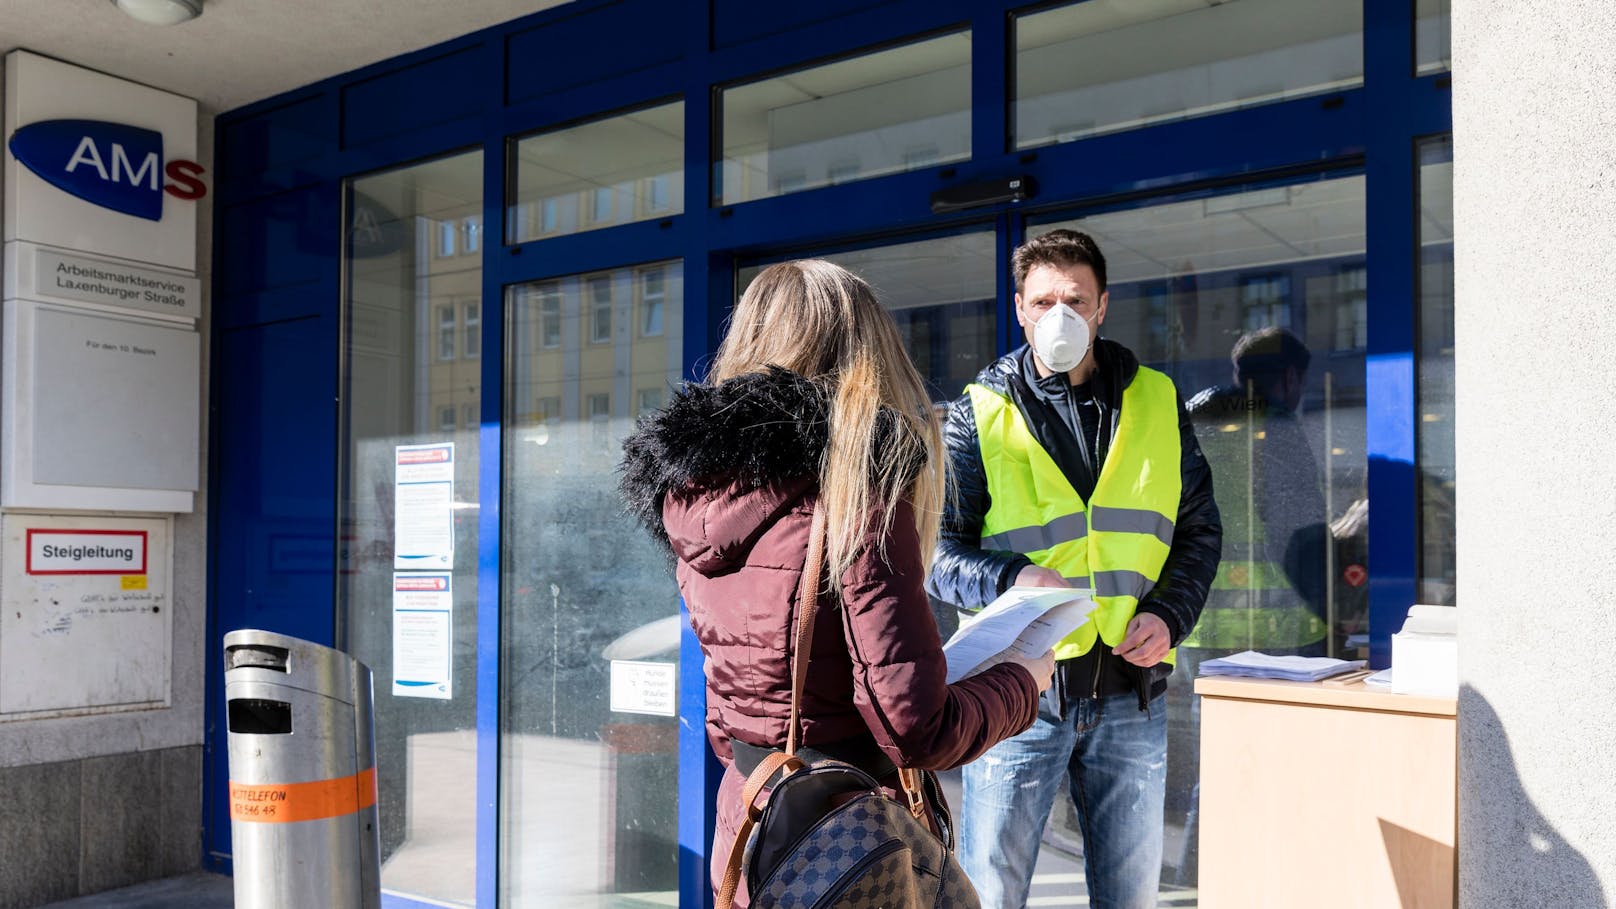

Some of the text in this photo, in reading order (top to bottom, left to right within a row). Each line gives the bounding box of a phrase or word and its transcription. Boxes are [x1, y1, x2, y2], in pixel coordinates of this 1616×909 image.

[65, 136, 207, 200] AMS
[56, 262, 186, 293] Arbeitsmarktservice
[56, 276, 186, 307] Laxenburger Straße
[42, 544, 134, 561] Steigleitung
